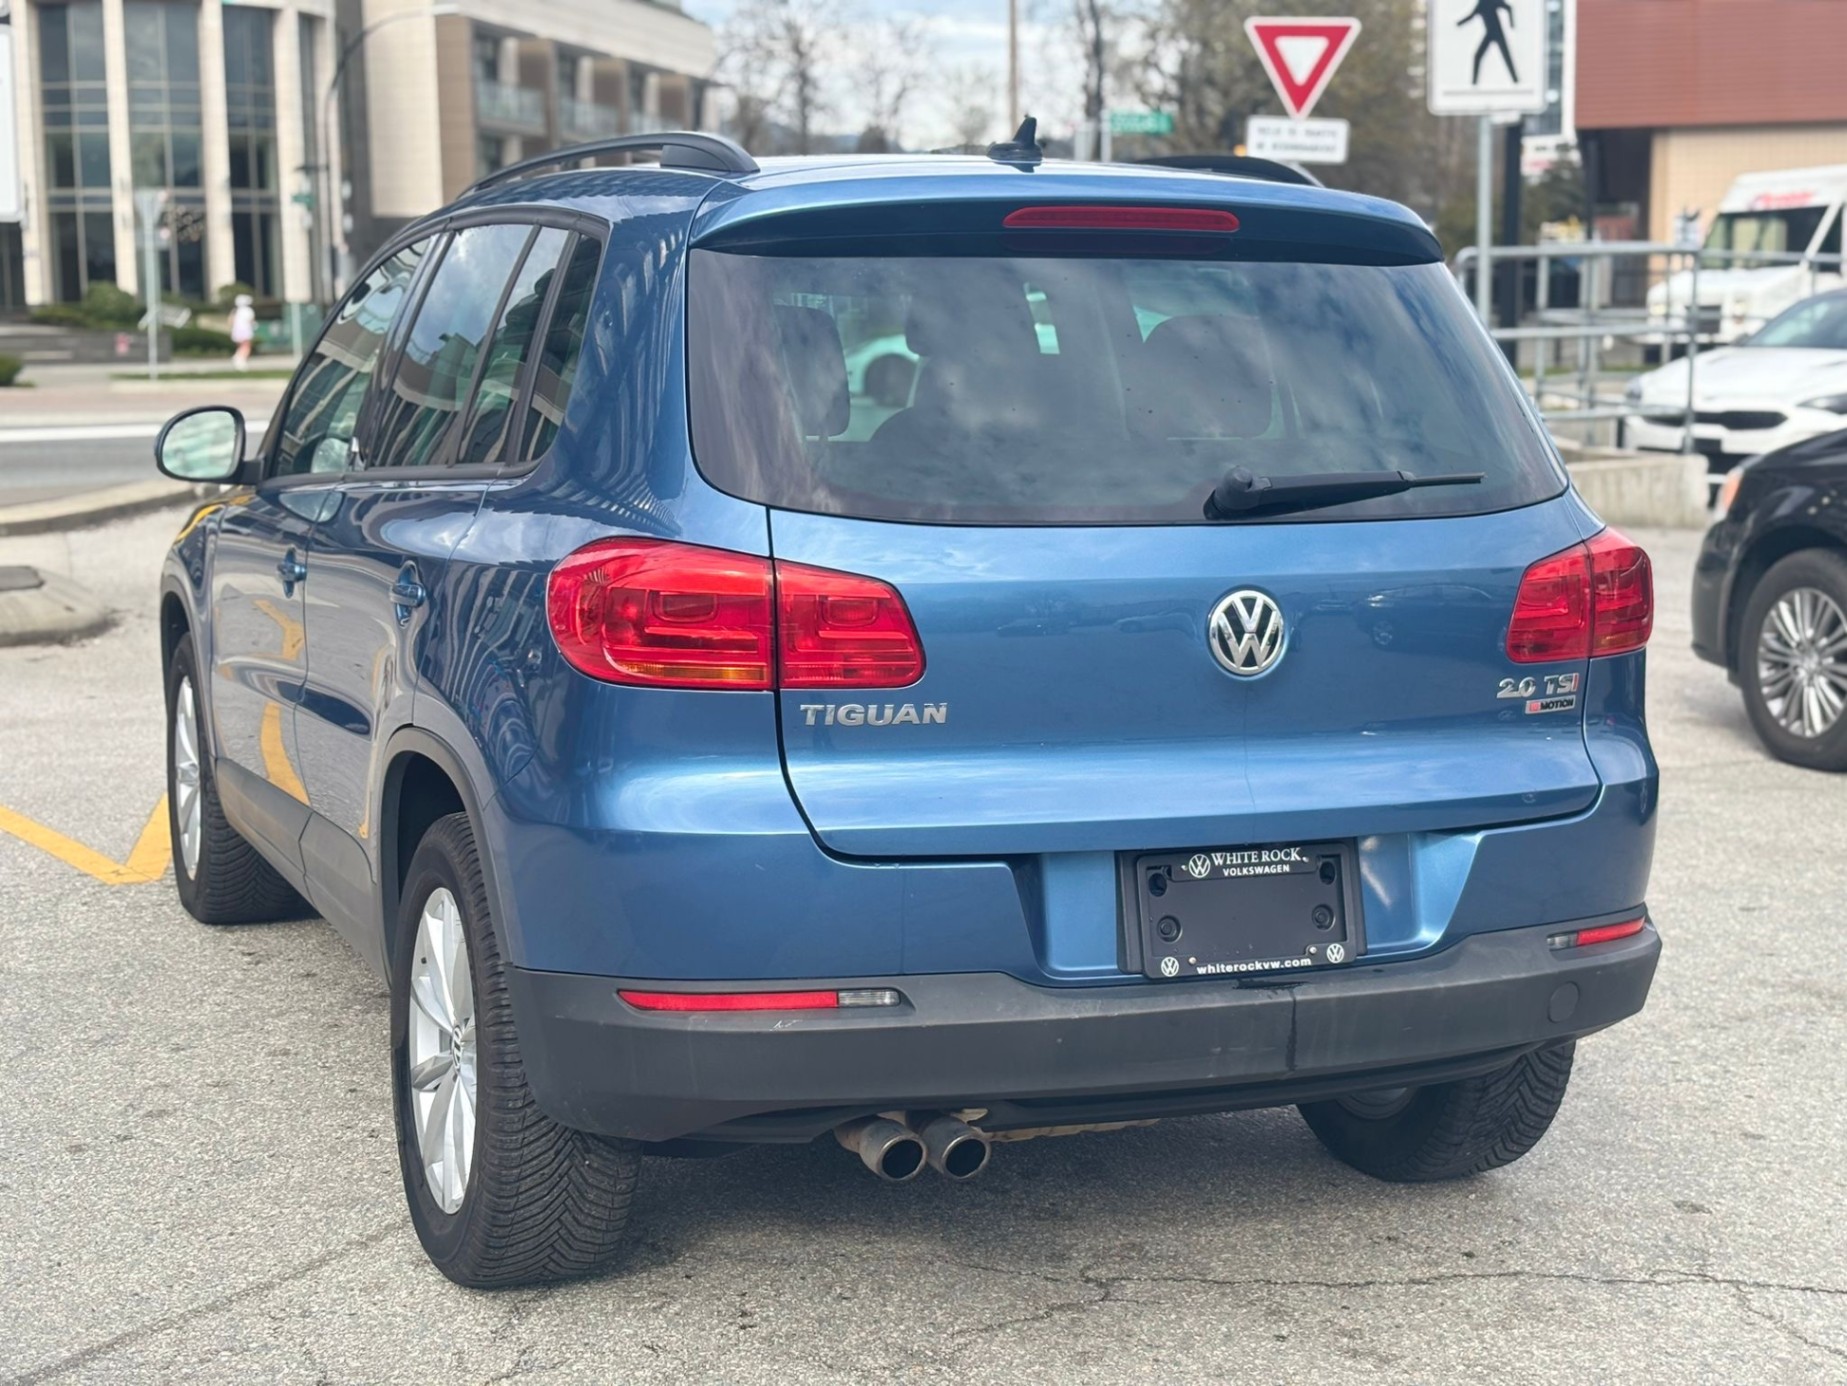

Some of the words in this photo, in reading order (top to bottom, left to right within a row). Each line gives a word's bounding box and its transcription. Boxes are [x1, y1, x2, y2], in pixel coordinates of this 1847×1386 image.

[1543, 672, 1579, 695] TSI
[800, 703, 948, 726] TIGUAN
[1211, 851, 1259, 866] WHITE
[1261, 847, 1302, 862] ROCK
[1223, 864, 1290, 876] VOLKSWAGEN
[1196, 958, 1312, 974] whiterockvw.com
